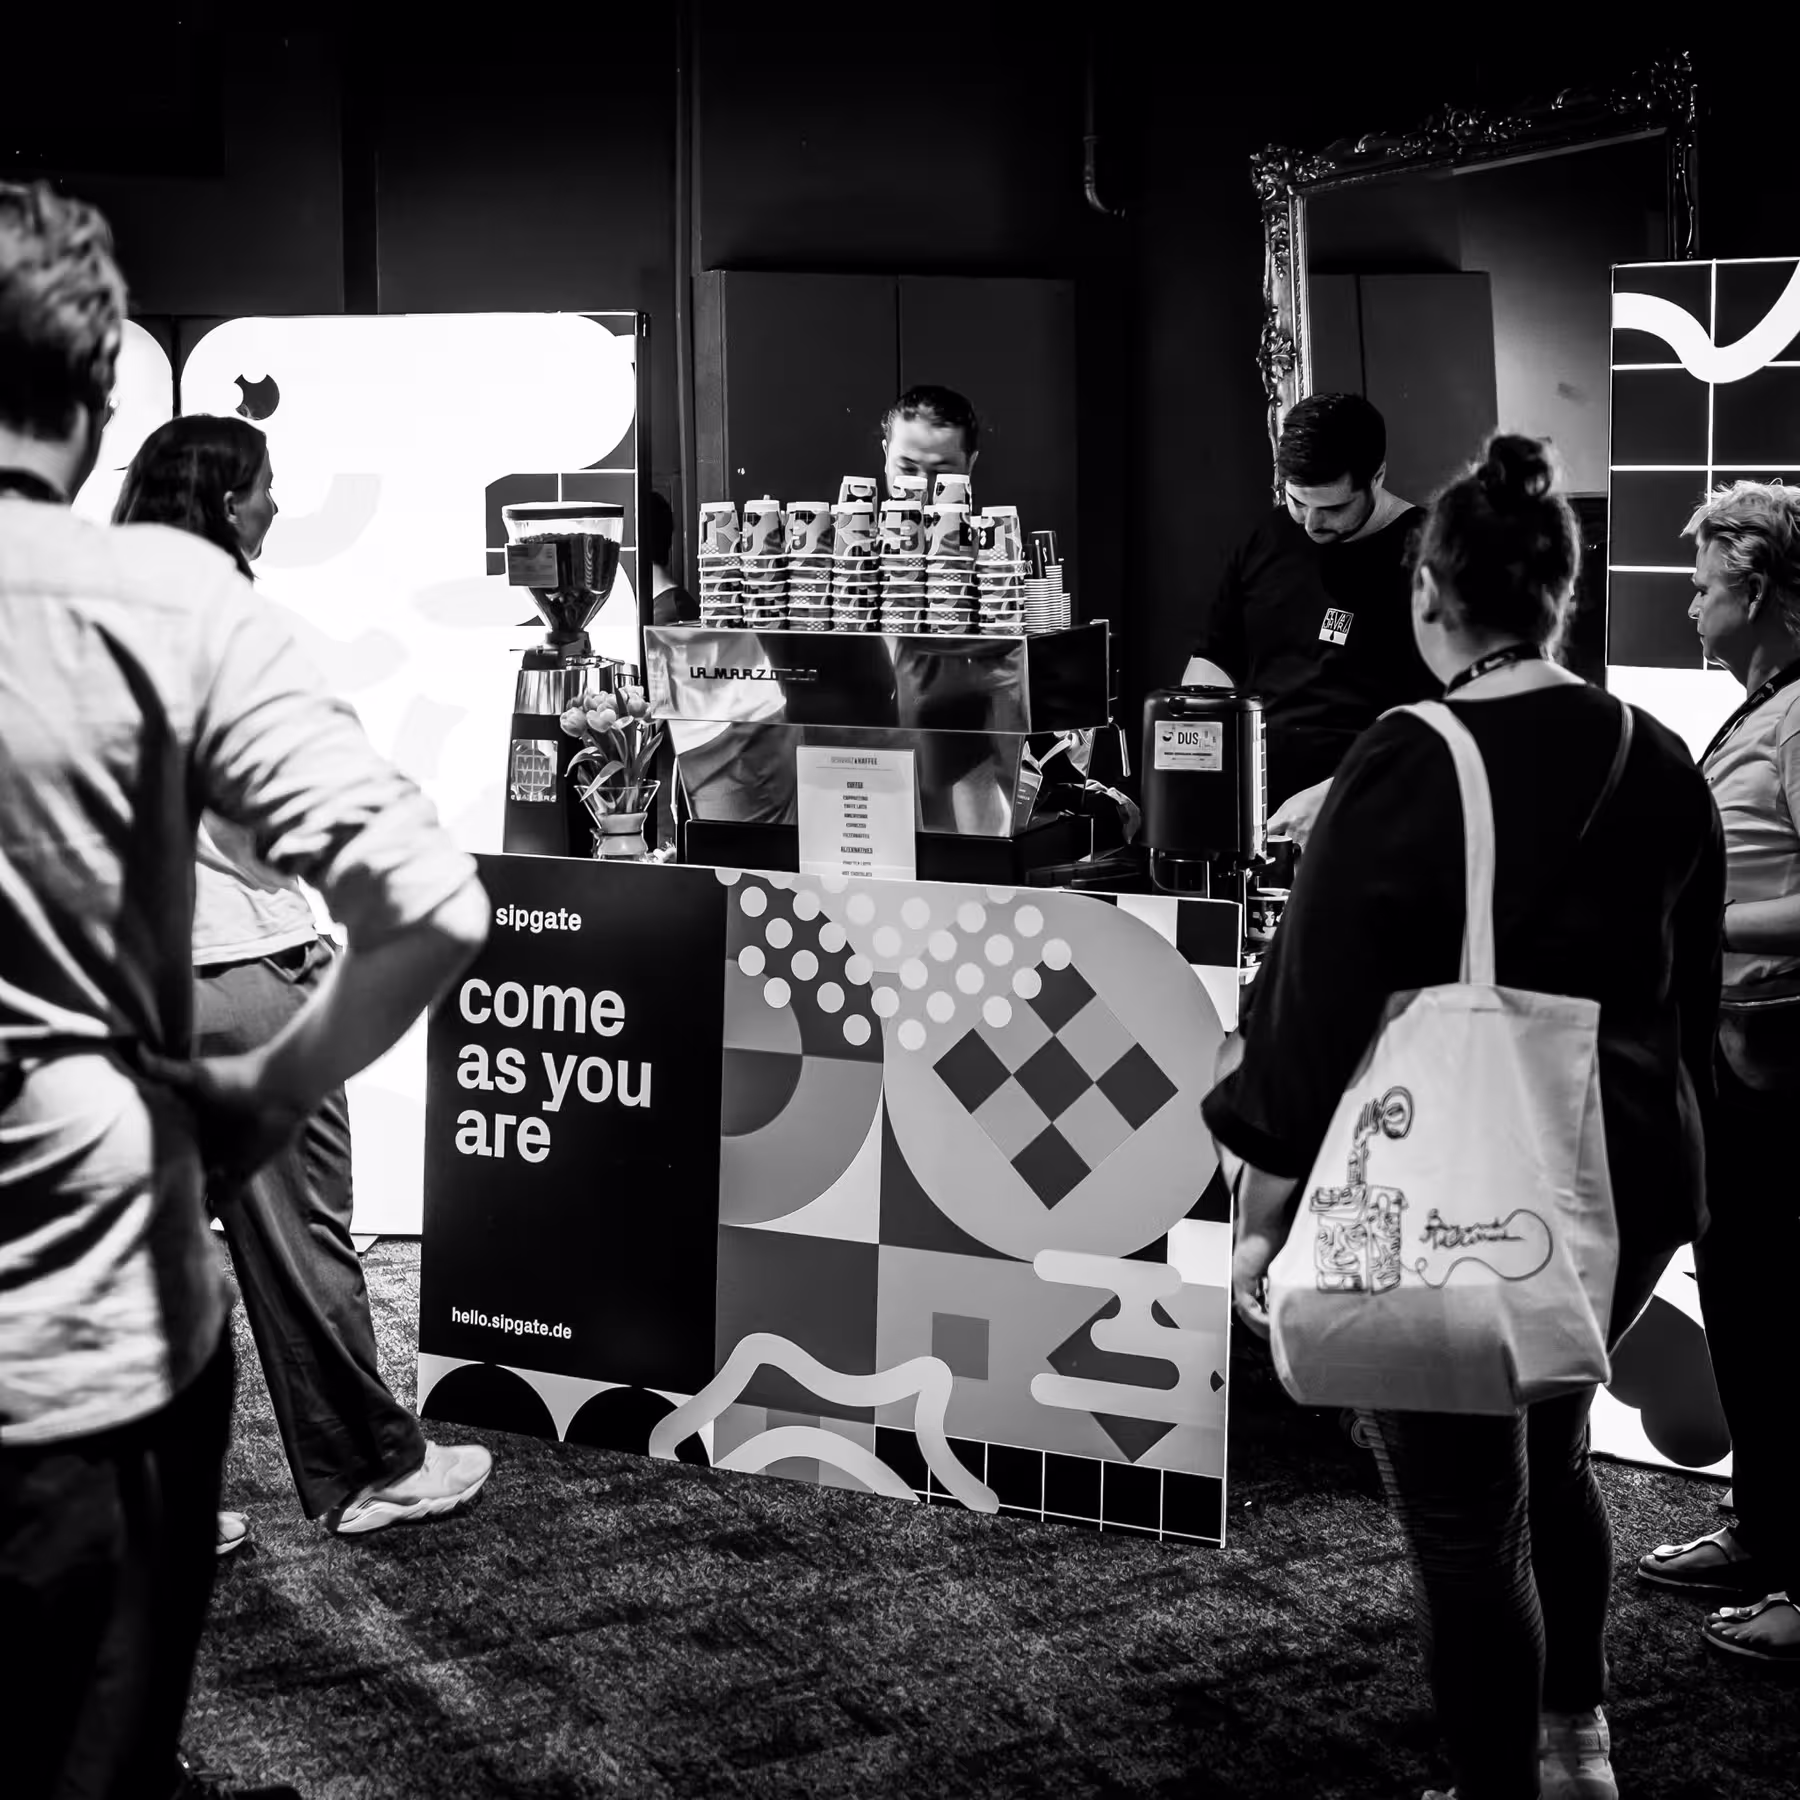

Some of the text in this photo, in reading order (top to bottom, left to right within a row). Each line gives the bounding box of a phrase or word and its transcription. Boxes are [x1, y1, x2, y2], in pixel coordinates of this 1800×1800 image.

[1177, 731, 1199, 745] DUS
[495, 904, 582, 934] sipgate
[459, 978, 626, 1038] come
[456, 1043, 653, 1112] as you
[454, 1109, 552, 1164] are
[451, 1306, 573, 1340] hello.sipgate.de
